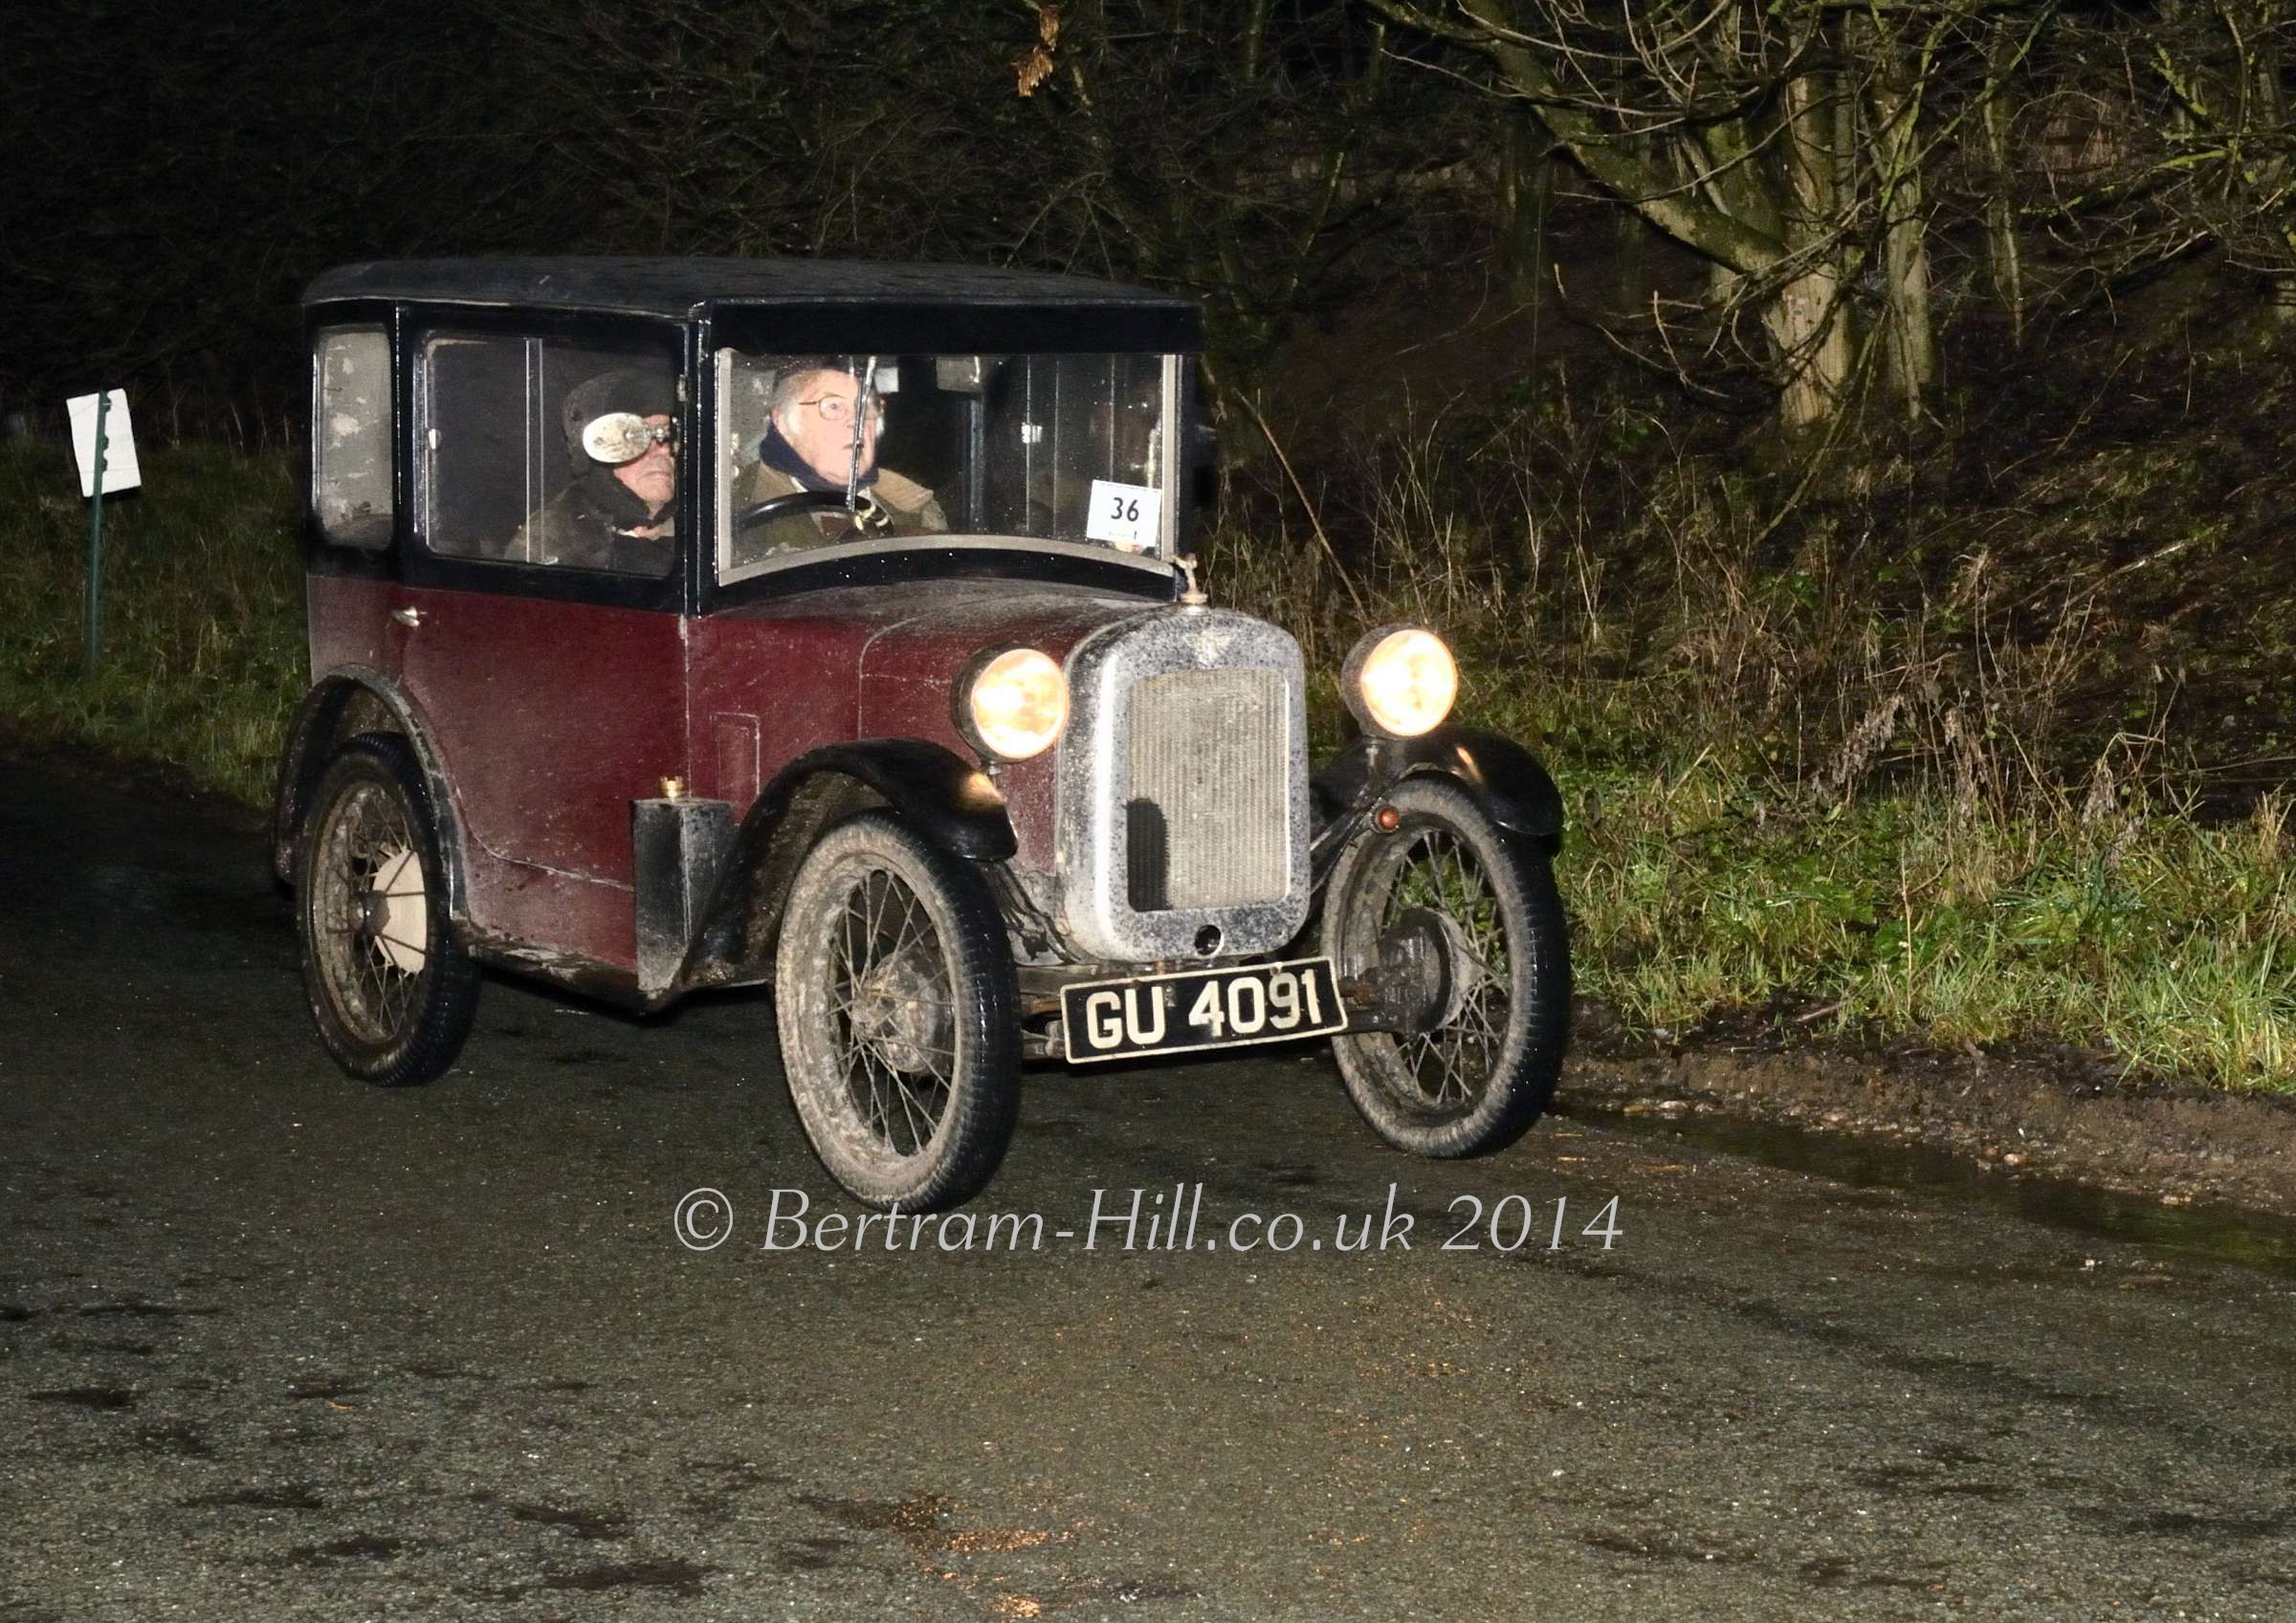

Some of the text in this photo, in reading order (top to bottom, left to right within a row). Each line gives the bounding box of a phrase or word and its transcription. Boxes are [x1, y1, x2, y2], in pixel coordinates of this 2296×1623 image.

[1110, 496, 1139, 522] 36
[1086, 968, 1322, 1050] GU 4091
